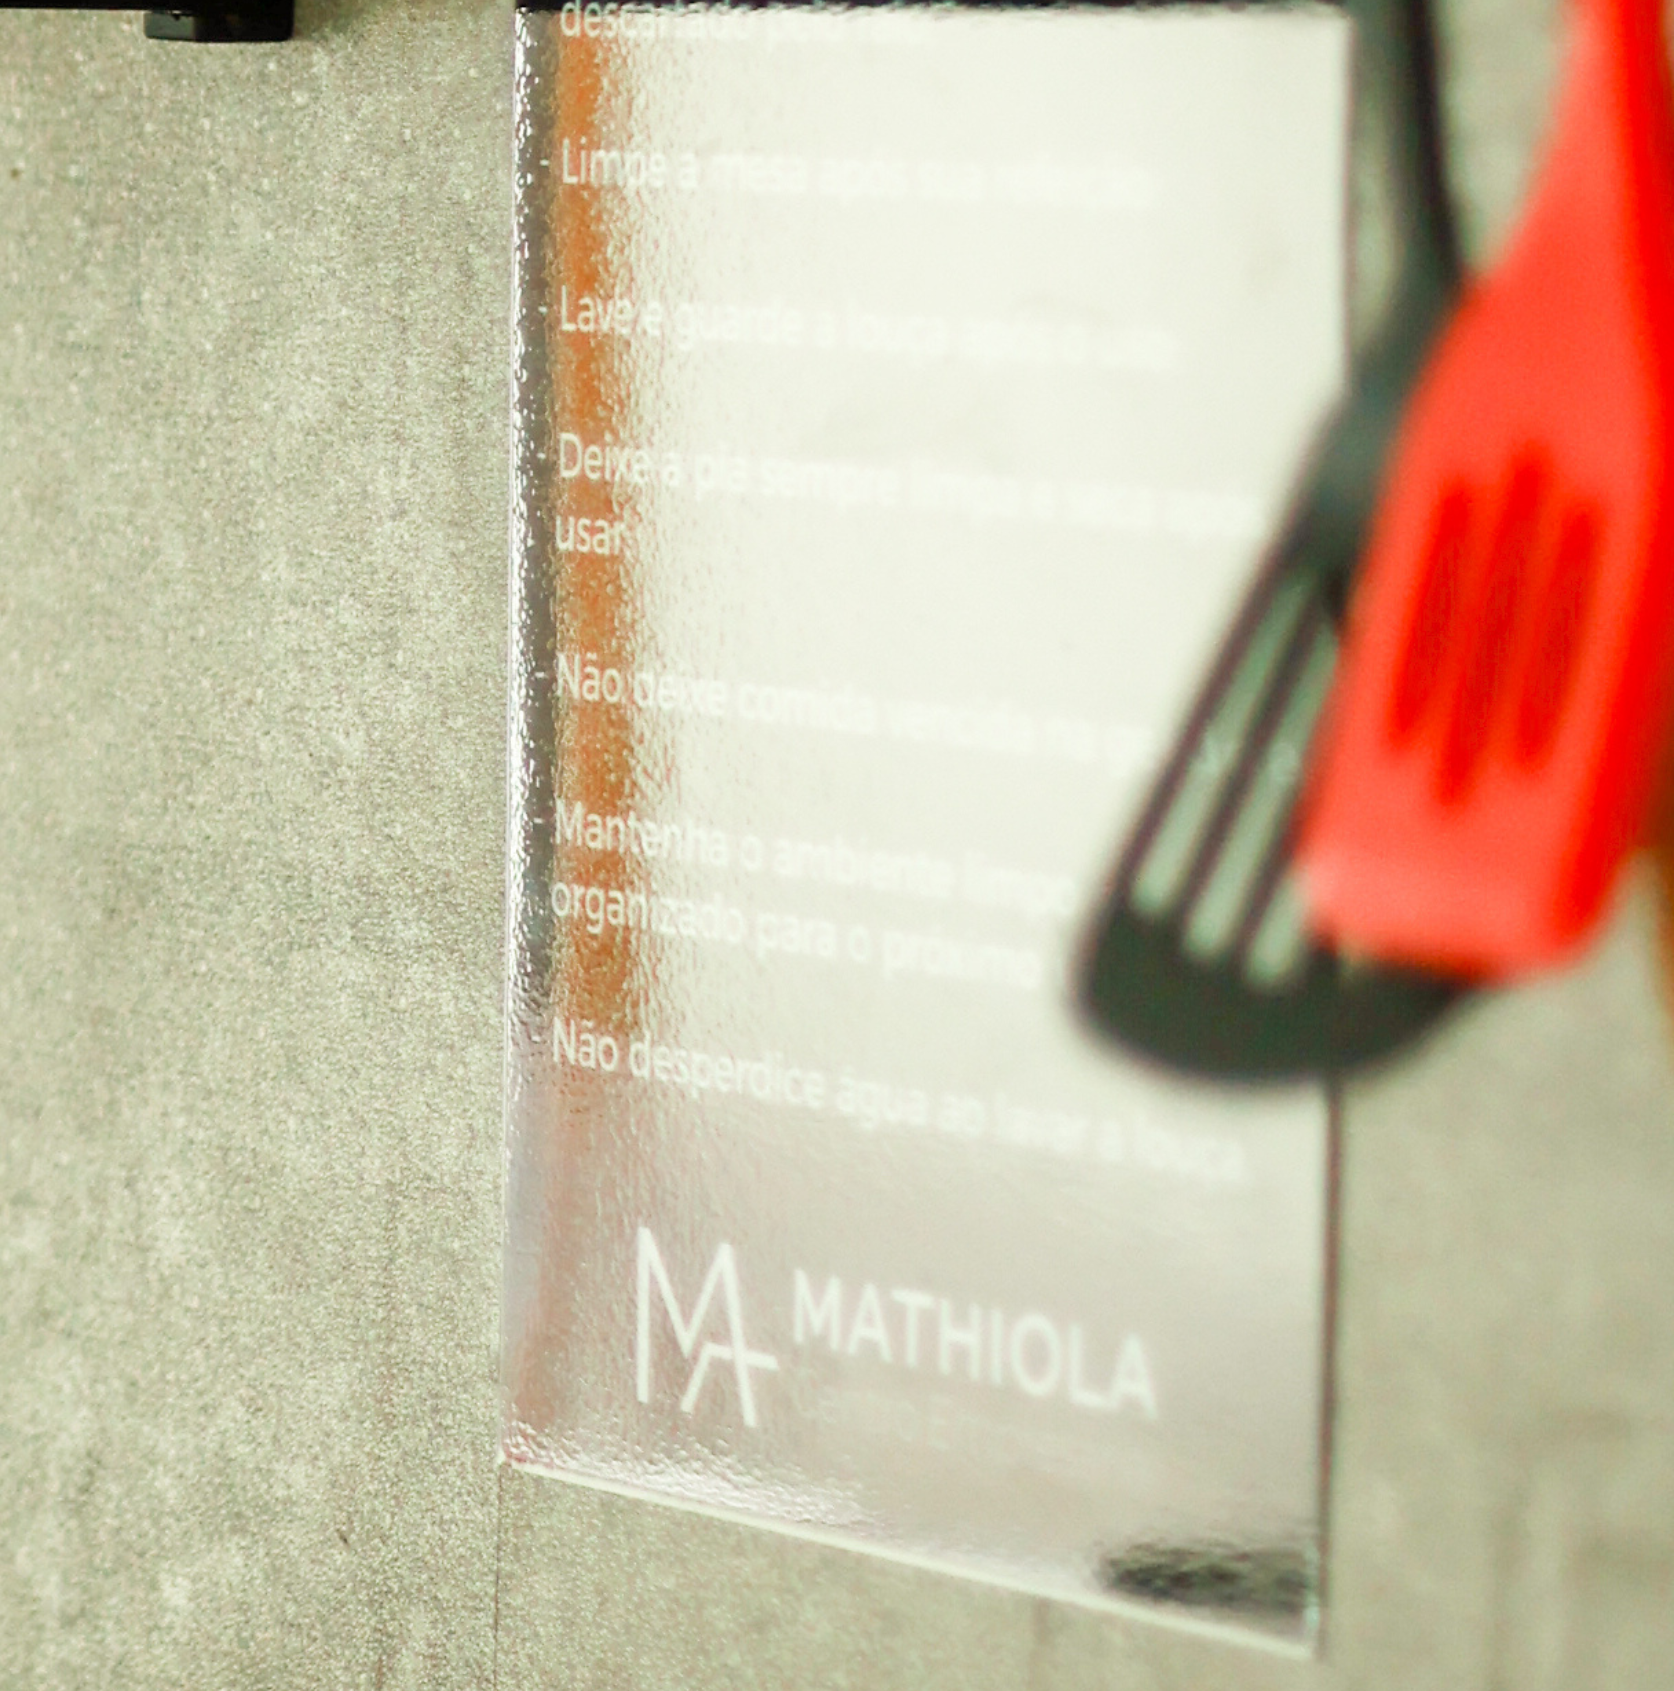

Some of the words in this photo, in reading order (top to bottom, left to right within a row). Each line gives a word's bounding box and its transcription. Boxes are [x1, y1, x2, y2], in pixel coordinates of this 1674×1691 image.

[560, 284, 636, 338] Lave
[555, 652, 624, 704] Não
[554, 798, 730, 868] Mantenha
[552, 881, 746, 944] organizado
[552, 1016, 620, 1073] Não
[628, 1029, 826, 1109] desperdice
[793, 1265, 1160, 1422] MATHIOLA
